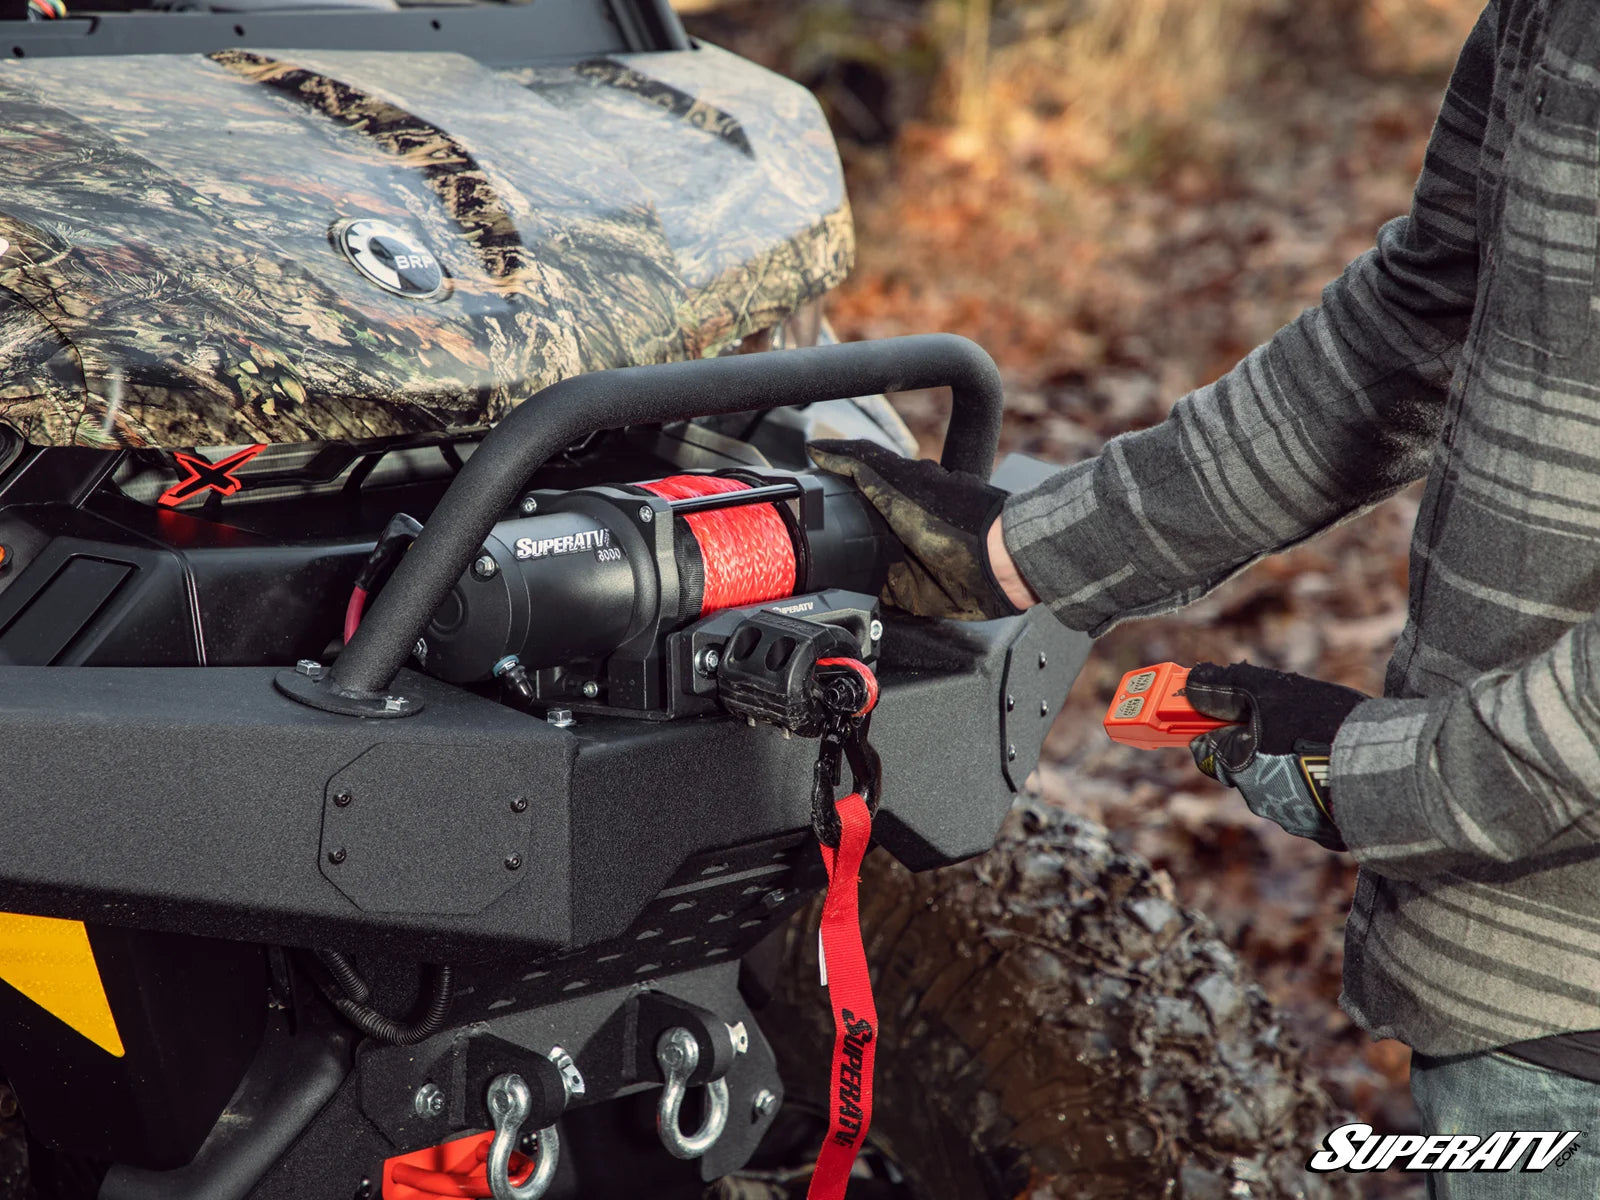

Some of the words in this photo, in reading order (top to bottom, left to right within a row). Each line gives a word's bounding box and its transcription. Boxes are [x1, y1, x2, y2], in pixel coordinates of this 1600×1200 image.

[395, 254, 434, 270] BRP
[515, 529, 605, 560] SUPERATV
[836, 1008, 873, 1149] SUPERATV
